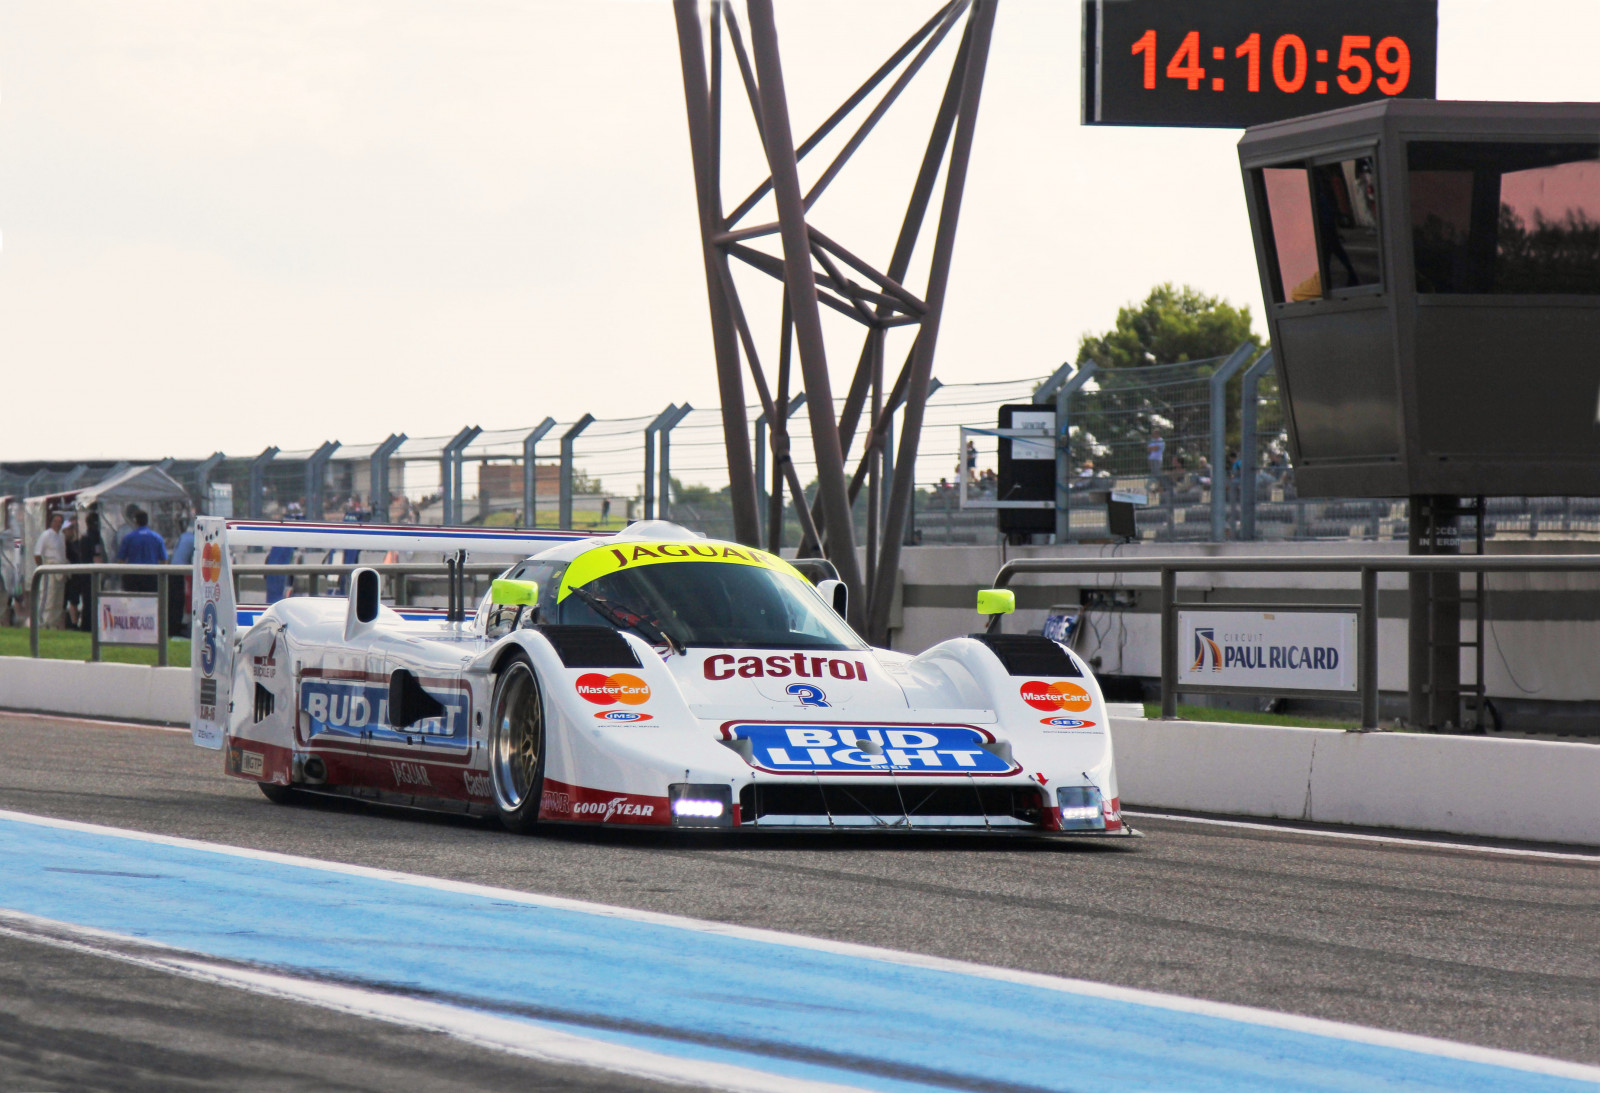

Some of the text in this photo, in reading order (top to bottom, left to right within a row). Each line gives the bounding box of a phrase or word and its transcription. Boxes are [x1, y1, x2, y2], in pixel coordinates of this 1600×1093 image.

[1131, 29, 1411, 96] 14:10:59
[1419, 538, 1460, 546] INERDIT
[611, 544, 776, 567] JAGUAR
[1224, 633, 1264, 642] CIRCUIT
[703, 652, 868, 682] Castrol
[1225, 645, 1339, 670] PAUL RICARD
[578, 685, 649, 694] MasterCard
[1022, 692, 1090, 702] MasterCard
[308, 692, 371, 727] BUD
[784, 729, 939, 749] BUD
[766, 748, 984, 768] LIGHT
[390, 760, 432, 787] JAGUAR
